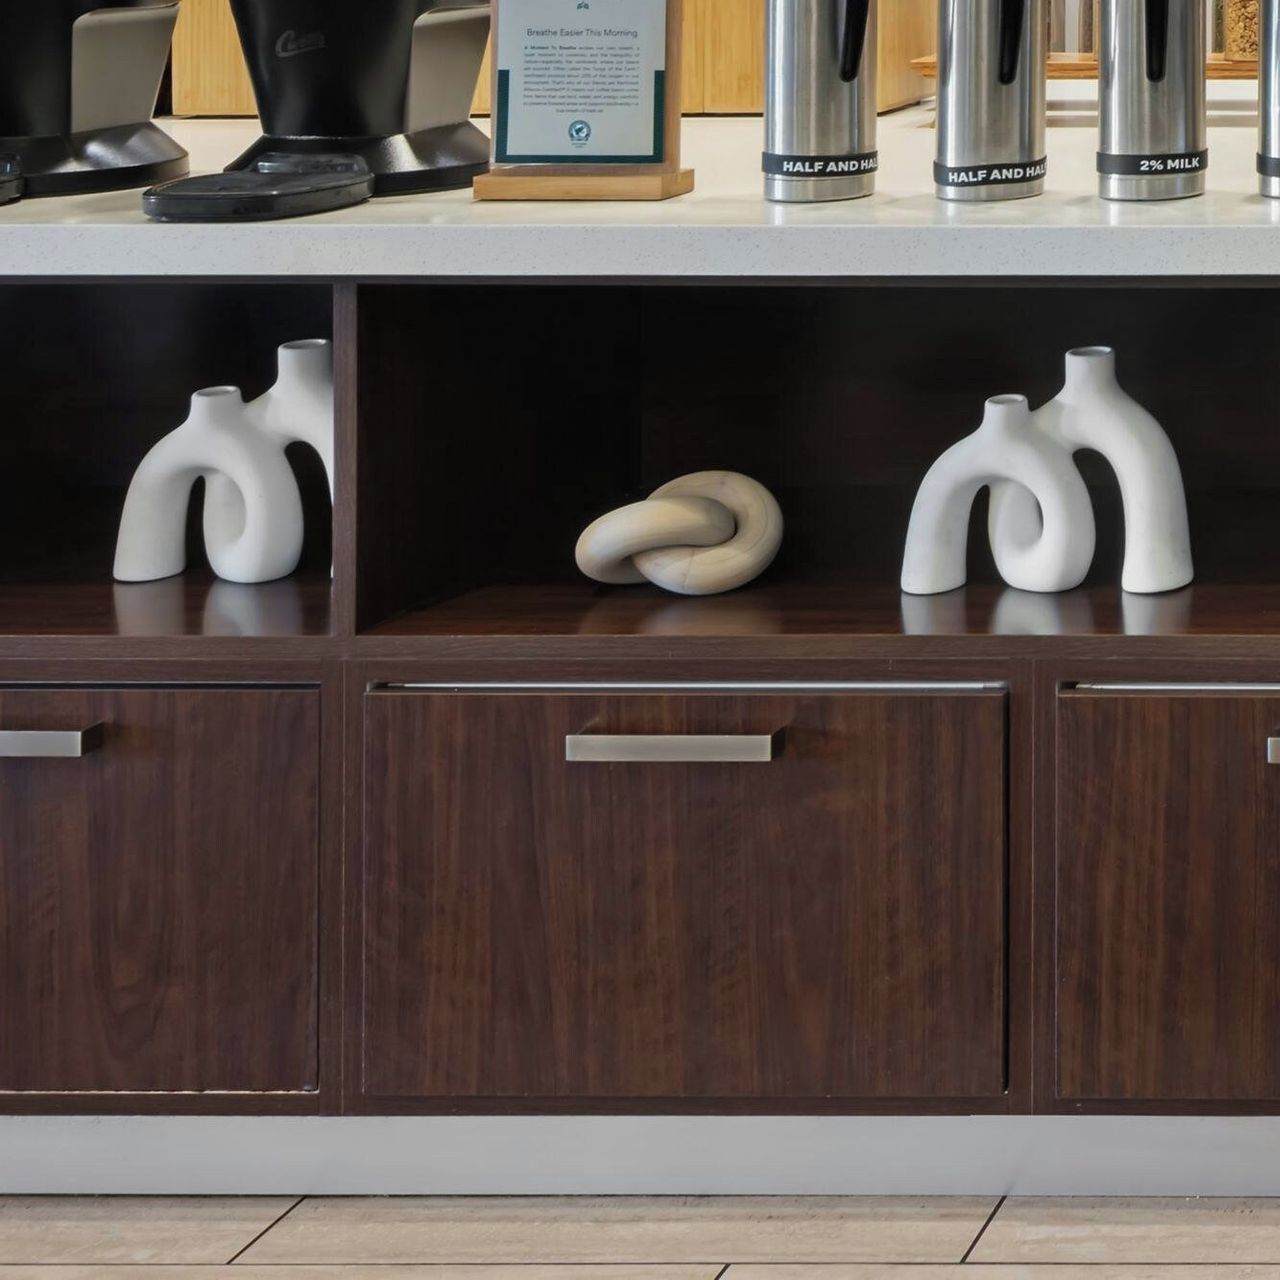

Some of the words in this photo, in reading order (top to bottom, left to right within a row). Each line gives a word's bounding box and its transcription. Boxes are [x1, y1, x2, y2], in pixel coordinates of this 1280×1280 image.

[526, 28, 558, 37] Breathe
[560, 28, 584, 37] Easier
[585, 28, 602, 37] This
[603, 28, 638, 38] Morning
[783, 161, 824, 173] HALF
[826, 160, 859, 172] AND
[1140, 160, 1164, 171] 2%
[1167, 157, 1200, 170] MILK
[948, 170, 988, 183] HALF
[989, 168, 1024, 180] AND
